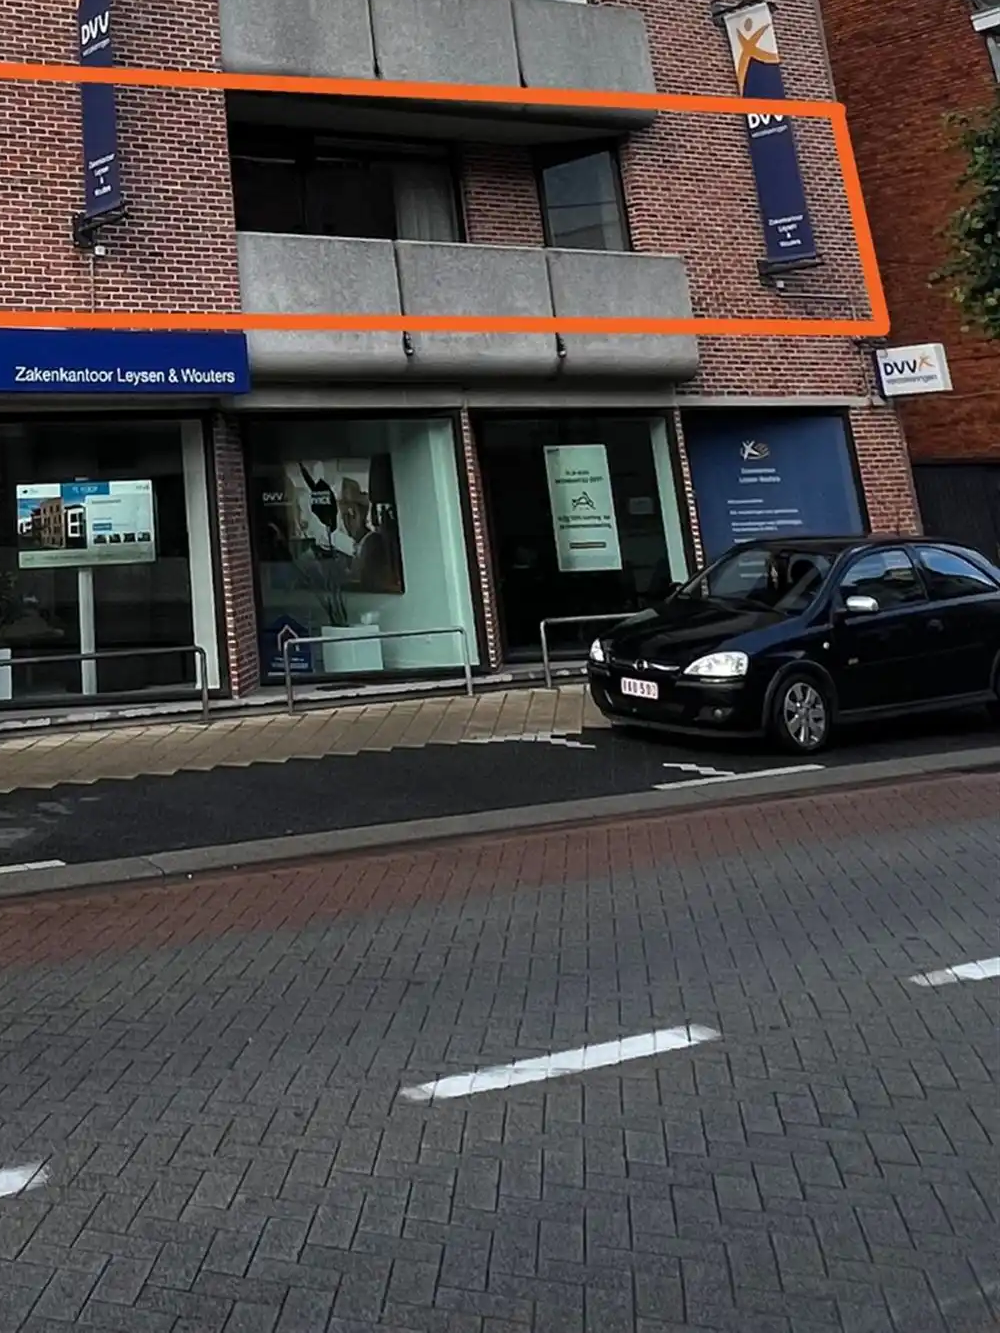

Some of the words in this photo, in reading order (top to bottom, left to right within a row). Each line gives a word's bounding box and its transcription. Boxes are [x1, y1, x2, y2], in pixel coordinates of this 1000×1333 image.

[81, 11, 109, 45] DVV
[15, 366, 114, 383] Zakenkantoor
[117, 367, 165, 386] Leysen
[168, 368, 179, 384] &
[180, 368, 236, 384] Wouters
[882, 359, 917, 376] DVV
